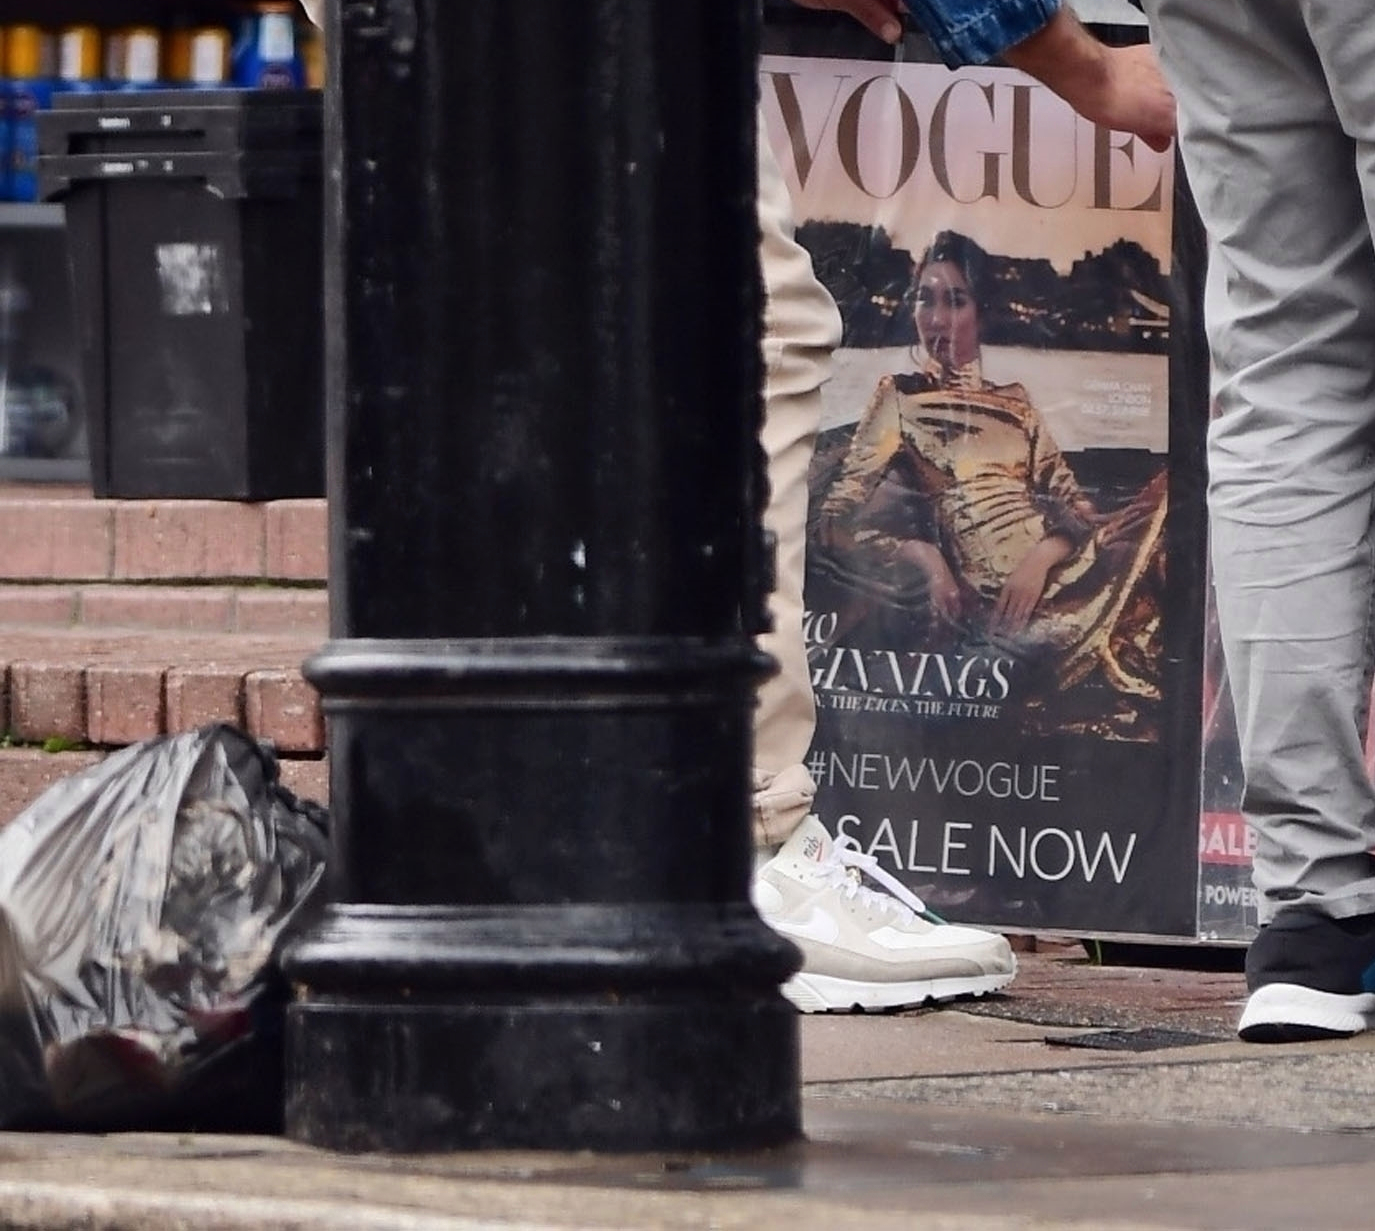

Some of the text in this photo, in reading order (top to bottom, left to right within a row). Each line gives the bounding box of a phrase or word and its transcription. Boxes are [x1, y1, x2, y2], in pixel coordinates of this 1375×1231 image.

[760, 71, 1164, 212] VOGUE
[808, 751, 1061, 802] #NEWVOGUE
[836, 812, 1137, 885] SALE NOW
